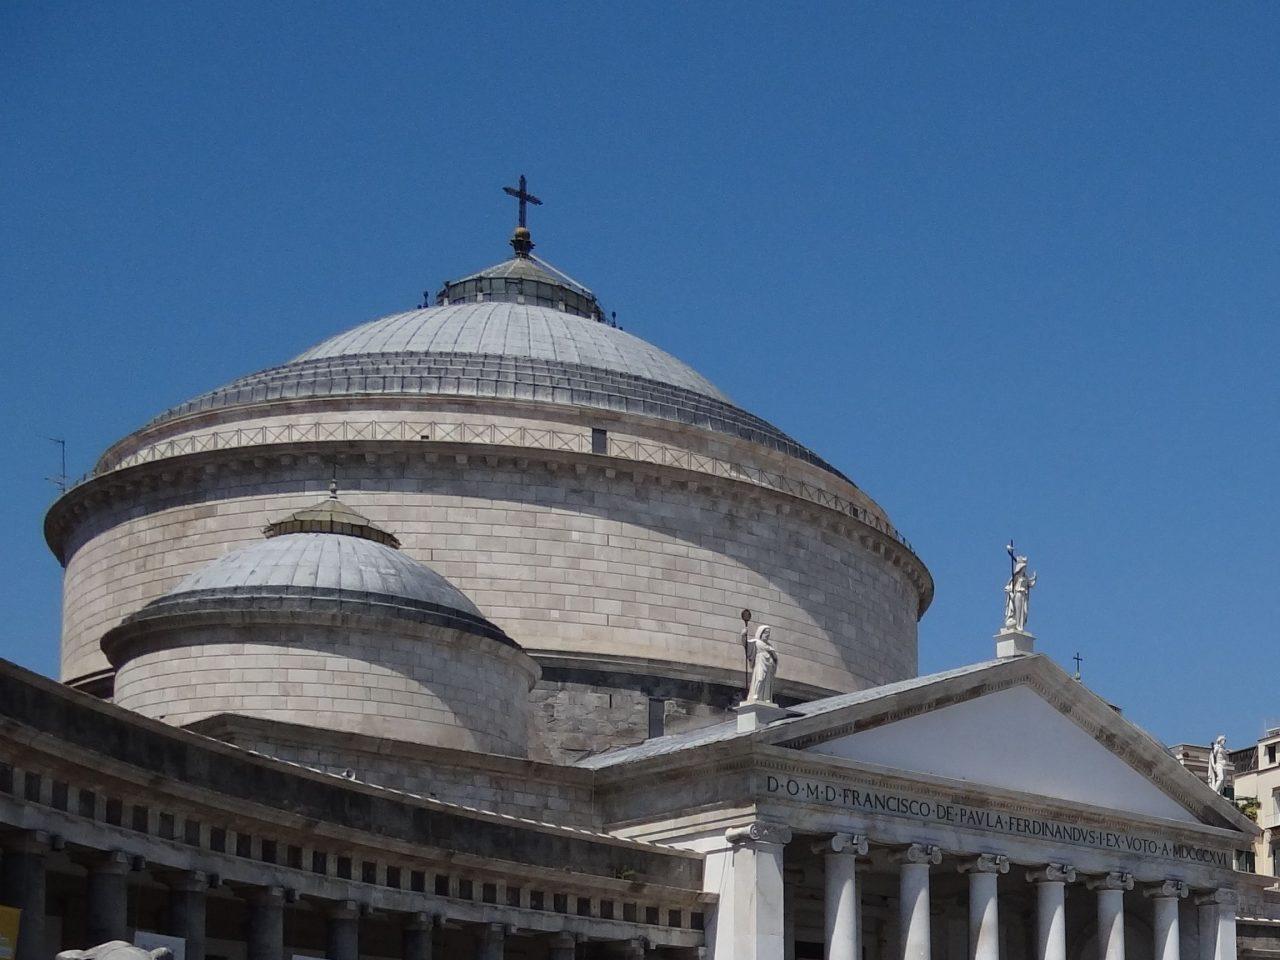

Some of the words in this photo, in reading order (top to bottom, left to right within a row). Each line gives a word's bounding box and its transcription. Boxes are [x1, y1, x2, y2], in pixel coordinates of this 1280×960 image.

[841, 788, 931, 816] FRANCISCO
[936, 804, 955, 821] DE
[959, 808, 1004, 830] PAVLA
[1125, 838, 1158, 854] VOTO
